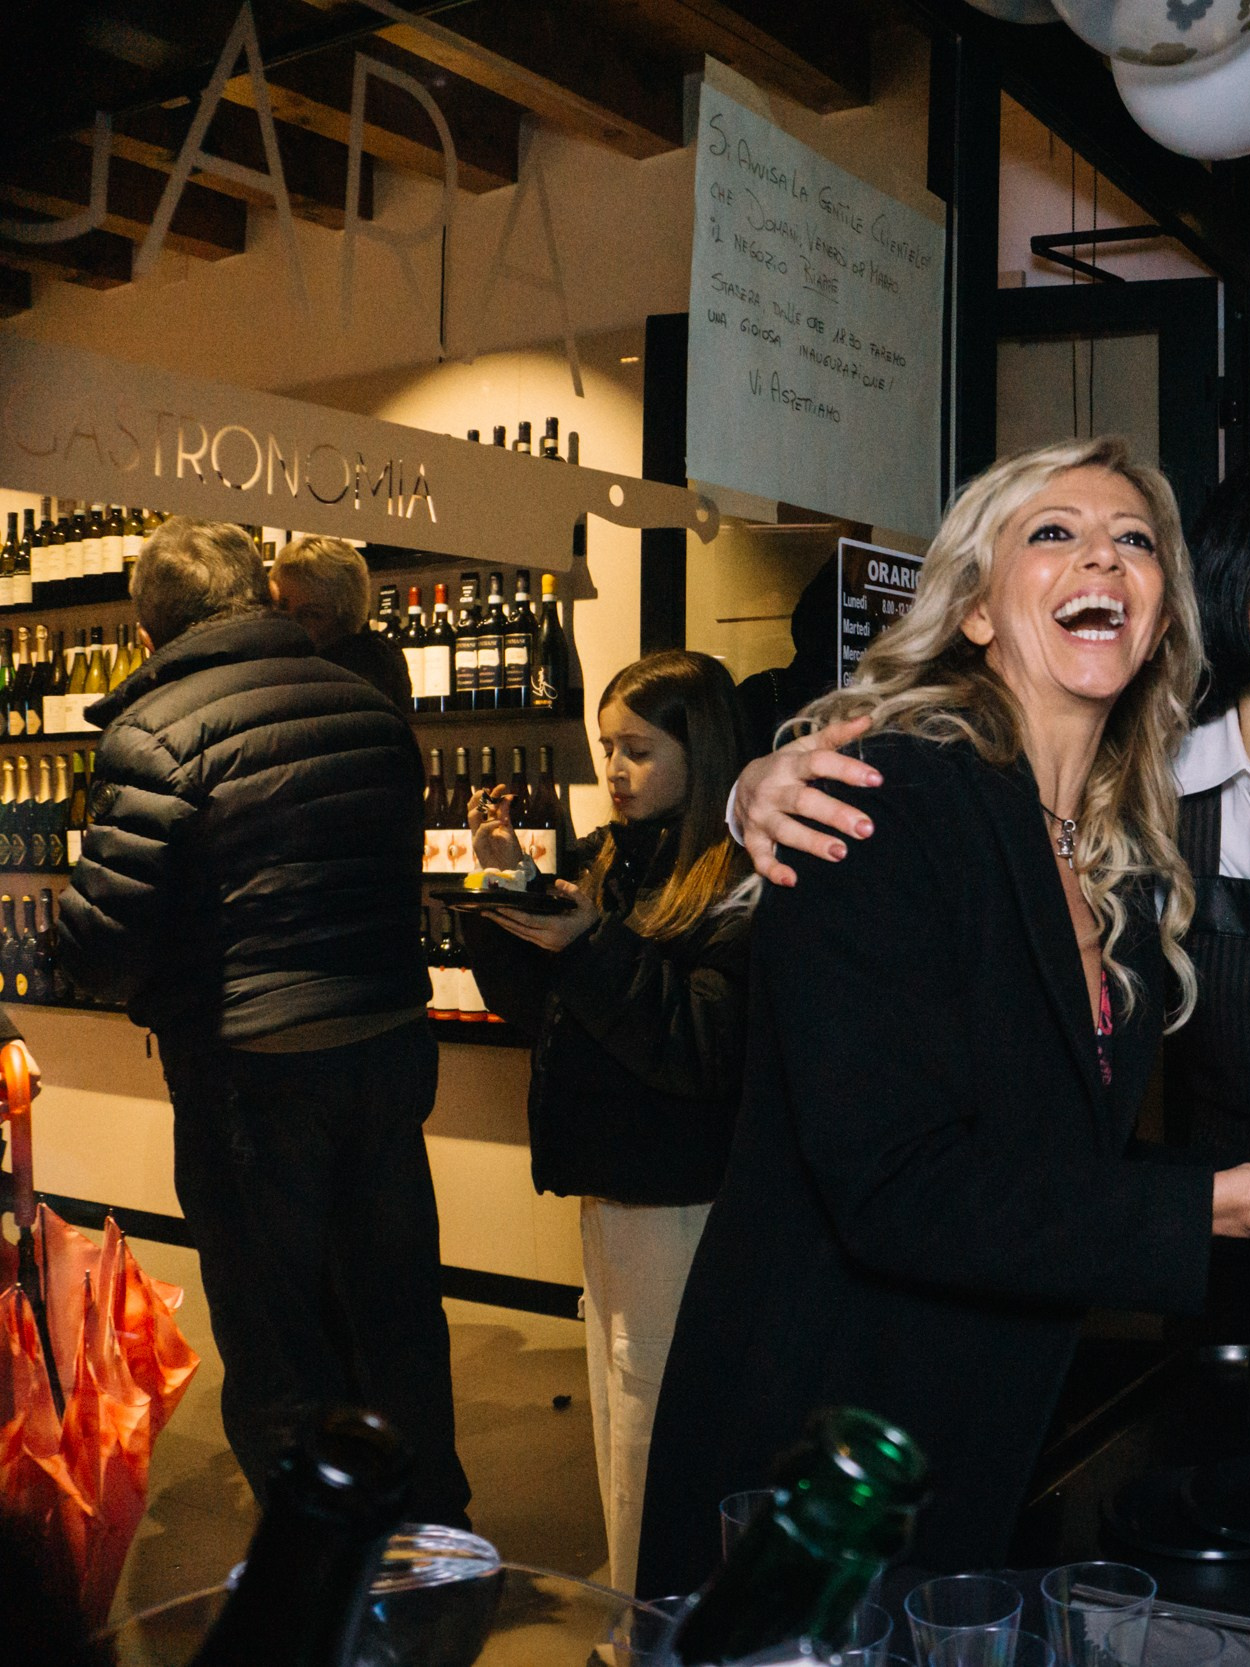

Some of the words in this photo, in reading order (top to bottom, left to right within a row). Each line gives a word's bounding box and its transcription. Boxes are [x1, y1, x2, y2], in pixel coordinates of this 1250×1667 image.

[710, 182, 733, 206] CHE
[791, 169, 809, 198] LA
[818, 185, 864, 234] GENTILE
[708, 309, 728, 328] UNA
[773, 301, 801, 326] DALLE
[832, 328, 862, 350] 18.30
[870, 344, 906, 367] FAREMO
